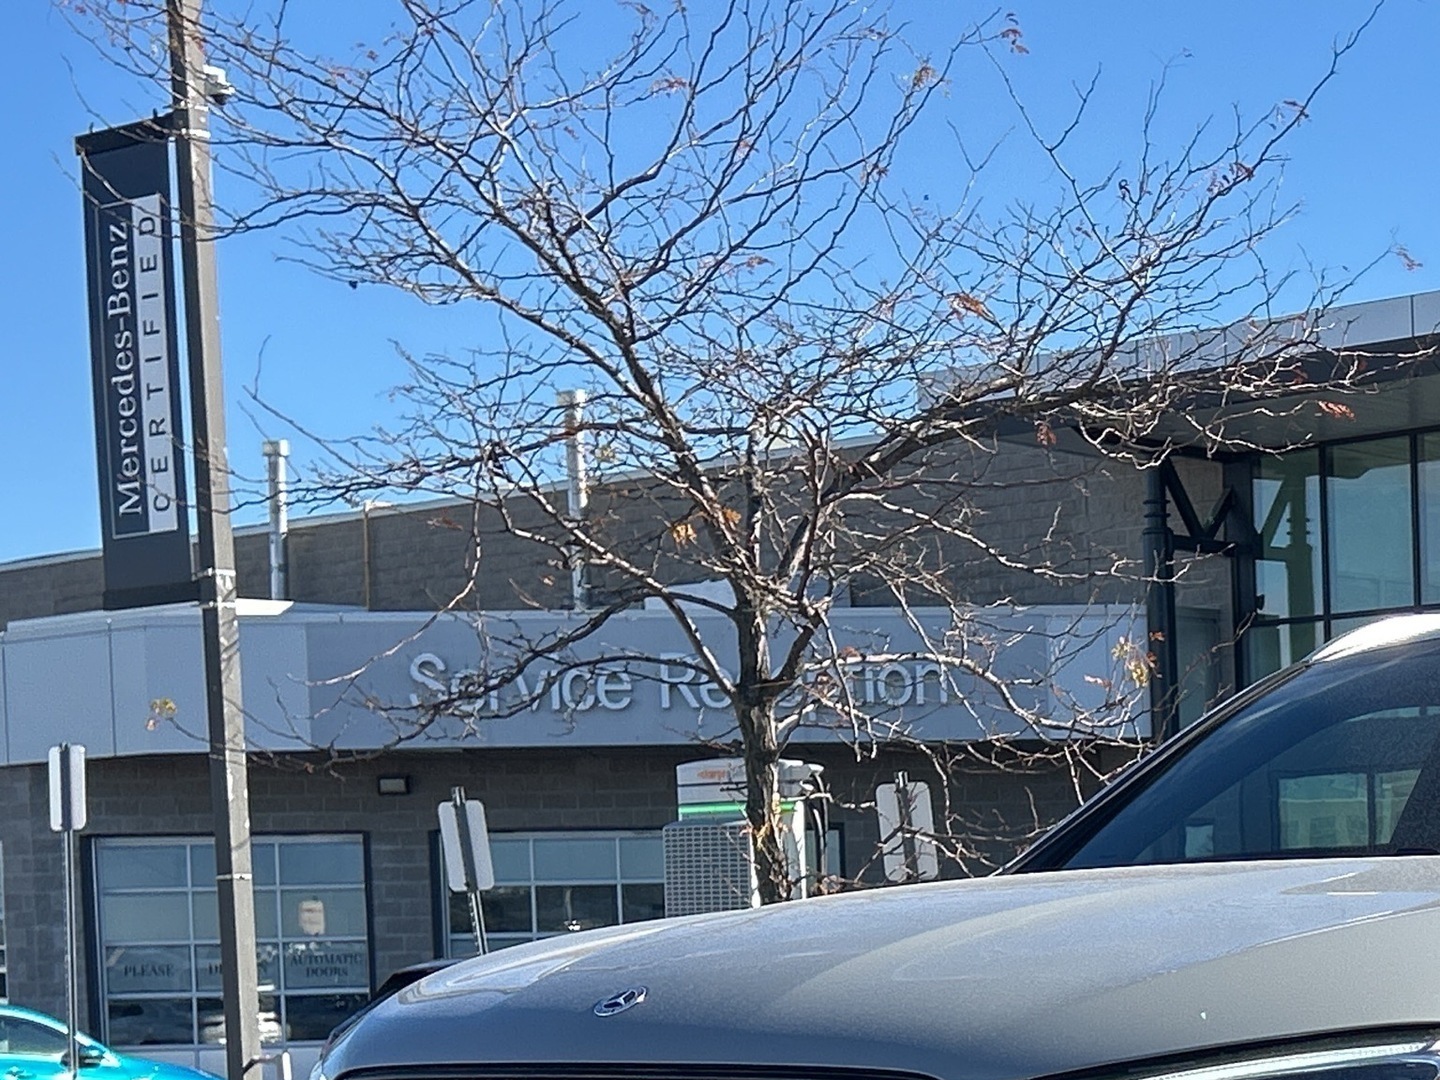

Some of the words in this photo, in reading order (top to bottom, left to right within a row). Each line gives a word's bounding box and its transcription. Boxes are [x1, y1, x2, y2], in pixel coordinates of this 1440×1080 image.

[107, 222, 143, 517] Mercedes-Benz
[139, 216, 171, 513] CERTIFIED
[409, 652, 633, 712] Service
[124, 963, 174, 977] PLEASE
[305, 966, 348, 978] DOORS
